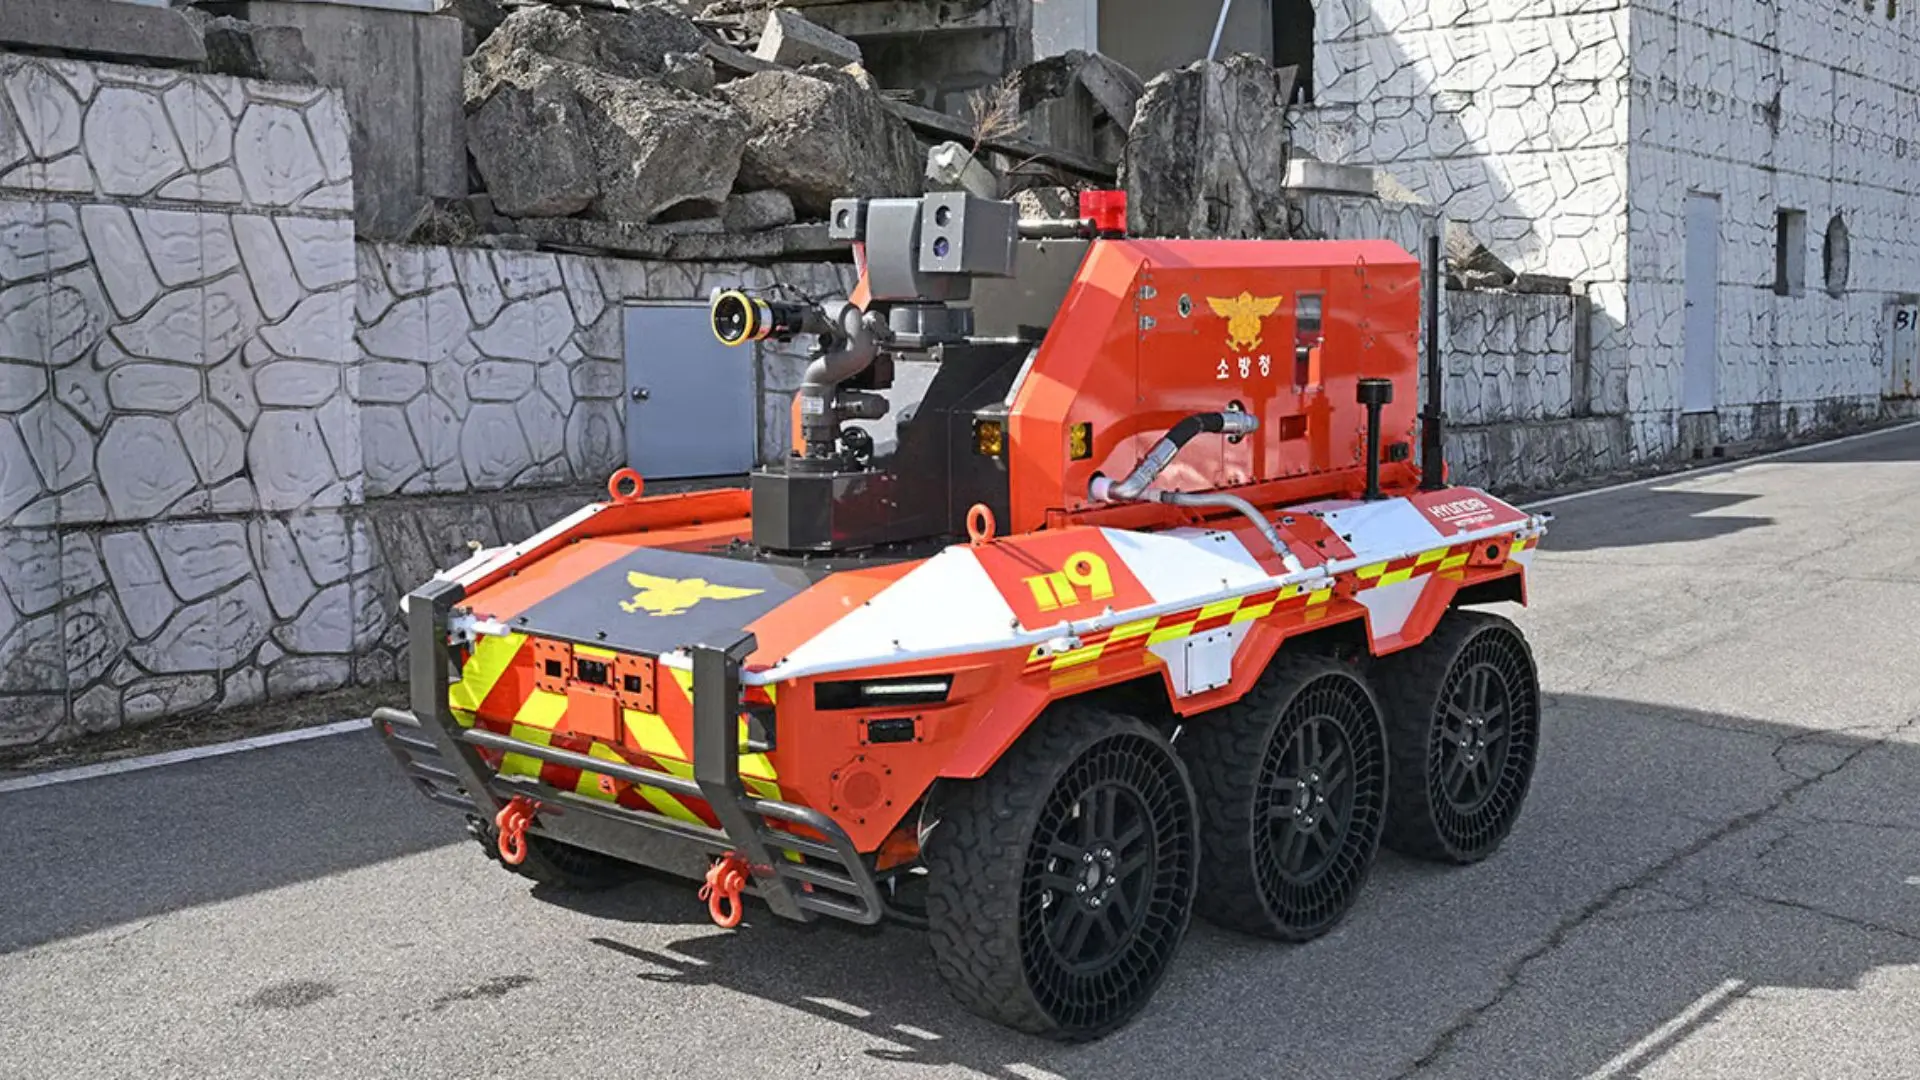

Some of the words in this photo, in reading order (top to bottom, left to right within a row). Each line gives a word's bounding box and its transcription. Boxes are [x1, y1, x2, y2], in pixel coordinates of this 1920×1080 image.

[1216, 354, 1271, 379] 소방청
[1427, 497, 1488, 518] HYUNDAI
[1021, 551, 1115, 612] 119
